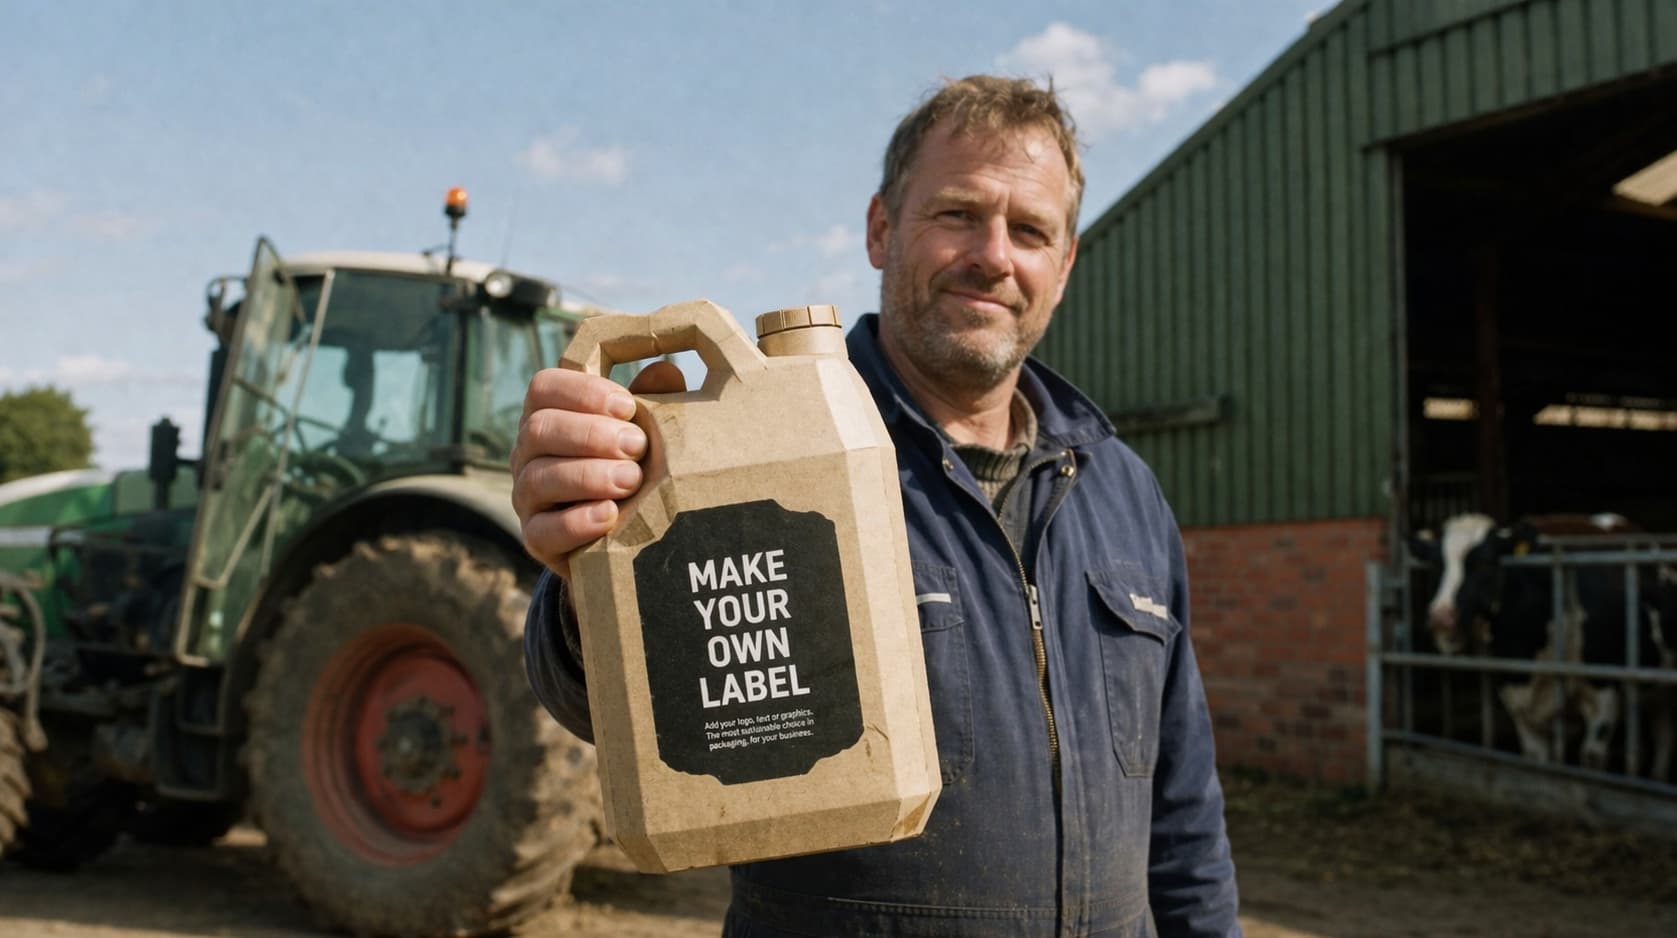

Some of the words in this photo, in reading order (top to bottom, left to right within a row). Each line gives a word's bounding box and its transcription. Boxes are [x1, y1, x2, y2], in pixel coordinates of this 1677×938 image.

[688, 549, 788, 593] MAKE
[693, 588, 792, 630] YOUR
[707, 627, 791, 668] OWN
[699, 664, 810, 708] LABEL
[705, 720, 720, 730] Add
[720, 720, 736, 730] your
[771, 713, 779, 721] or
[780, 708, 814, 721] graphics.
[705, 732, 720, 740] The
[721, 728, 740, 738] most
[782, 720, 806, 729] choice
[806, 717, 815, 725] in
[750, 735, 760, 744] for
[760, 734, 778, 744] your
[779, 730, 814, 740] business.
